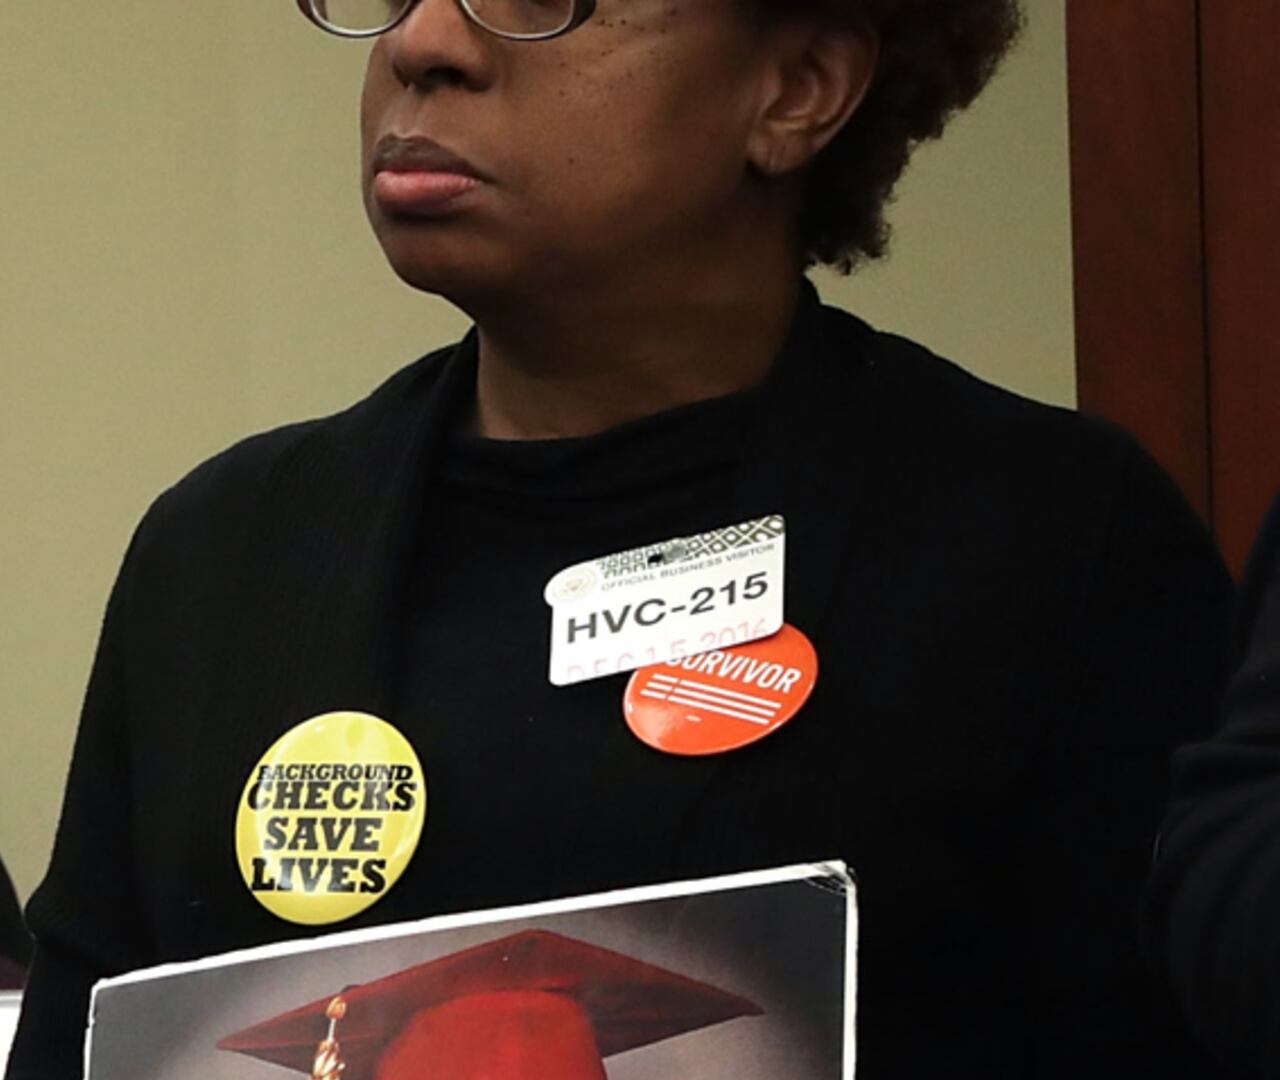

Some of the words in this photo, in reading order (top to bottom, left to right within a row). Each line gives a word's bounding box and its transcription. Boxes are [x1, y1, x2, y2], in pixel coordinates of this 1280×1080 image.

[660, 555, 723, 579] BUSINESS
[726, 543, 775, 561] VISITOR
[567, 571, 769, 645] HVC-215
[257, 764, 414, 781] BACKGROUND
[247, 782, 417, 812] CHECKS
[263, 817, 382, 852] SAVE
[251, 858, 387, 893] LIVES
